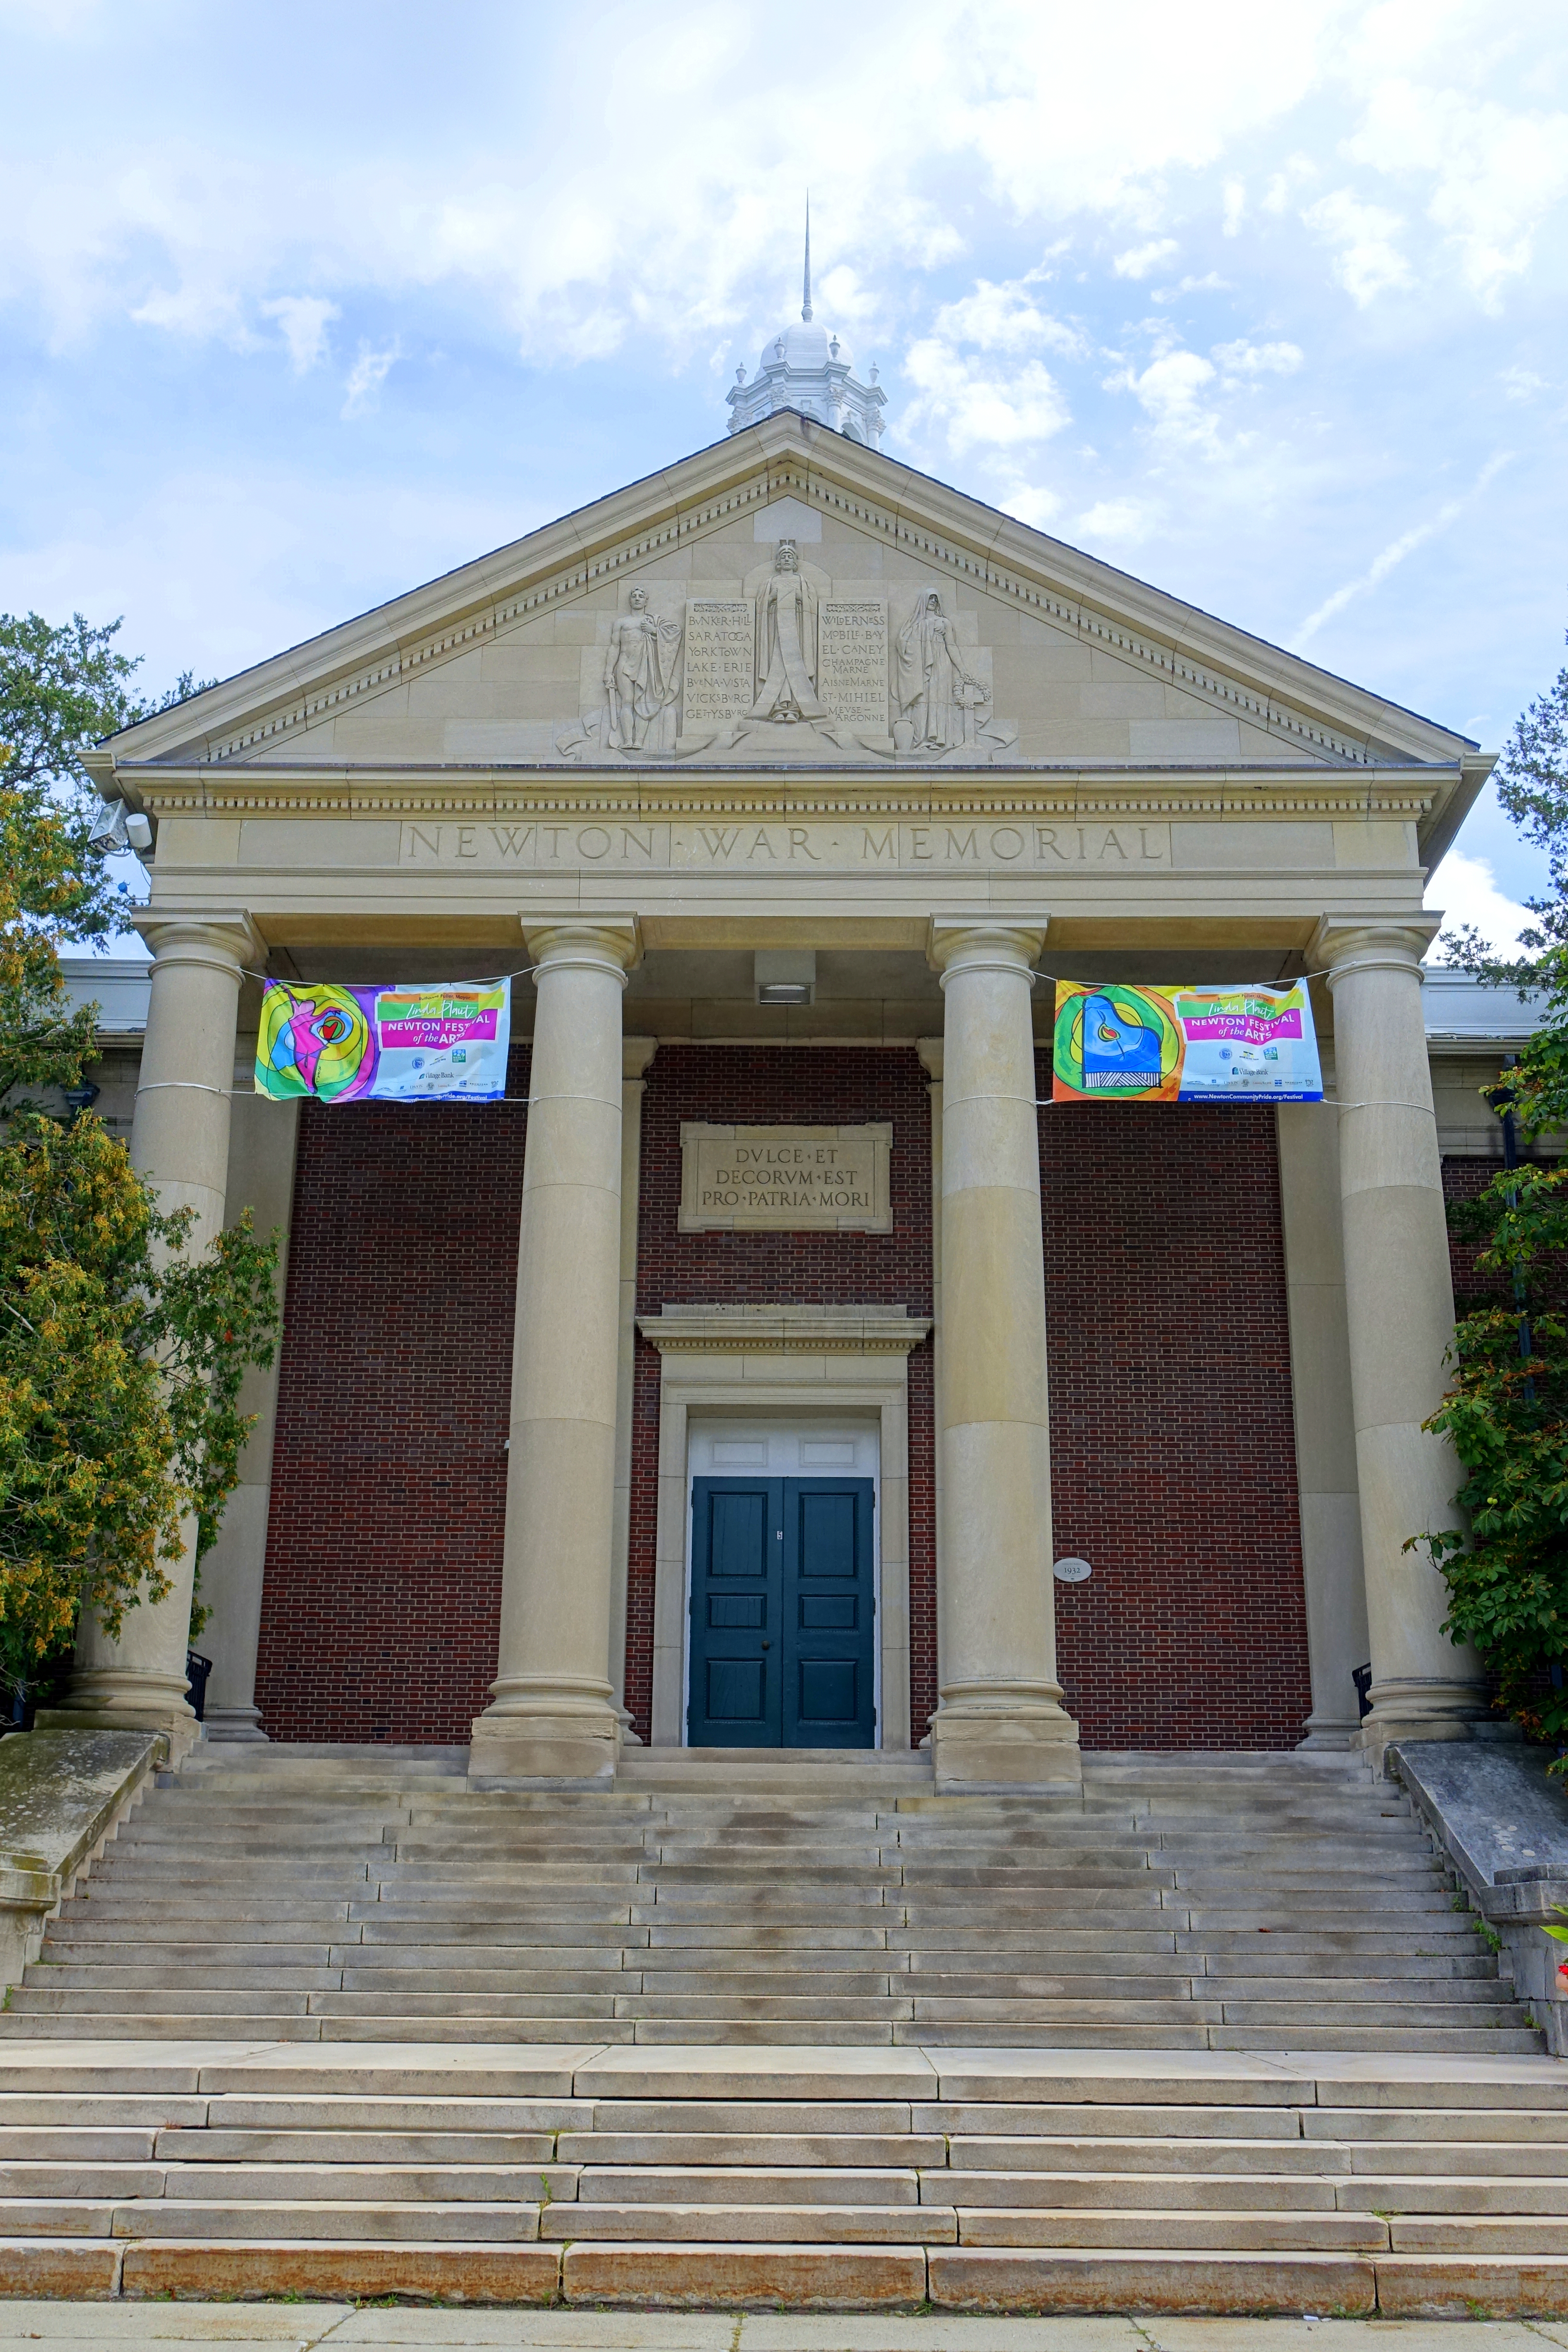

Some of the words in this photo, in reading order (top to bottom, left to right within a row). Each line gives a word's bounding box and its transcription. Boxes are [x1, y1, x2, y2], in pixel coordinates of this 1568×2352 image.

[732, 614, 752, 625] HILL
[822, 616, 885, 626] WILDERNESS
[689, 632, 751, 641] SARATOGA
[823, 631, 859, 640] MOBILE
[865, 631, 884, 640] BAY
[689, 647, 752, 656] YORKTOWN
[823, 645, 836, 654] EL
[842, 645, 884, 654] CANEY
[687, 663, 717, 672] LAKE
[724, 663, 751, 672] ERIE
[723, 678, 750, 687] VISTA
[838, 693, 885, 702] MIHIEL
[836, 714, 885, 722] ARGONNE
[408, 826, 655, 860] NEWTON
[696, 827, 821, 860] WAR
[861, 827, 1163, 860] MEMORIAL
[406, 1002, 436, 1020] Linda
[438, 1000, 477, 1021] Plaut
[1208, 1001, 1239, 1017] Linda
[1240, 999, 1275, 1020] Plaut
[388, 1022, 440, 1031] NEWTON
[1191, 1018, 1245, 1026] NEWTON
[1250, 1014, 1295, 1032] FESTIVAL
[413, 1032, 424, 1044] of
[424, 1033, 438, 1042] the
[1219, 1027, 1229, 1037] of
[1230, 1027, 1244, 1035] the
[1245, 1028, 1272, 1041] ARTS
[816, 1149, 838, 1164] ET
[824, 1171, 858, 1185] EST
[702, 1191, 739, 1205] PRO
[748, 1191, 812, 1206] PATRIA
[819, 1192, 869, 1207] MORI
